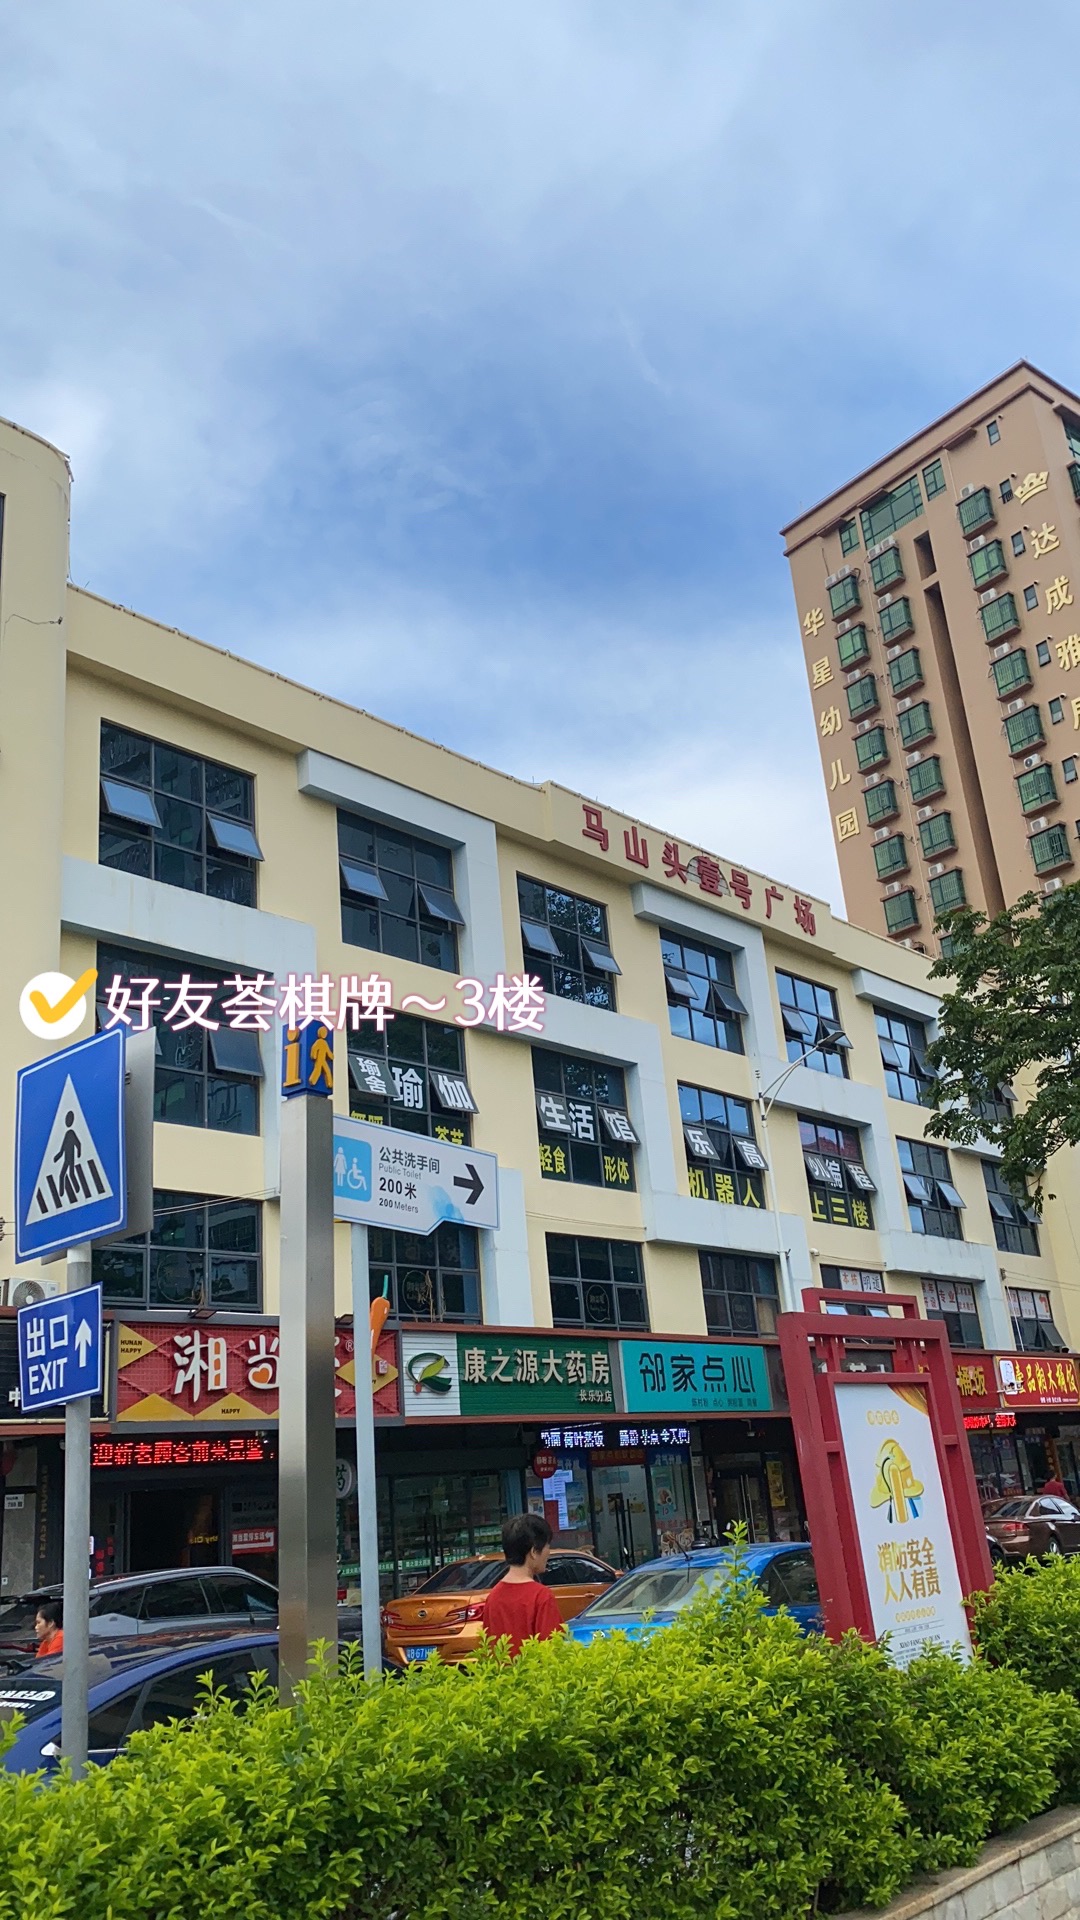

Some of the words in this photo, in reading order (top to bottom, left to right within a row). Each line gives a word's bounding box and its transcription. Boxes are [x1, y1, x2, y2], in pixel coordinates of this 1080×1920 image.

[803, 606, 861, 842] 华星幼儿园
[582, 804, 816, 936] 马山头壹号广场
[356, 1057, 387, 1094] 瑜舍
[540, 1096, 636, 1143] 生活馆
[379, 1146, 440, 1174] 公共洗手间
[539, 1143, 566, 1174] 轻食
[604, 1155, 630, 1184] 形体
[687, 1130, 765, 1168] 乐高
[378, 1163, 402, 1176] Public
[402, 1168, 422, 1181] Toilet
[379, 1177, 417, 1200] 200米
[688, 1167, 760, 1208] 机器人
[812, 1191, 870, 1228] 上三楼
[26, 1314, 69, 1360] 出口
[28, 1357, 68, 1396] EXIT
[464, 1346, 611, 1385] 康之源大药房
[638, 1352, 757, 1394] 邻家点心
[578, 1389, 613, 1403] 长乐分店
[877, 1536, 937, 1573] 消防安全
[883, 1566, 942, 1606] 人人有责
